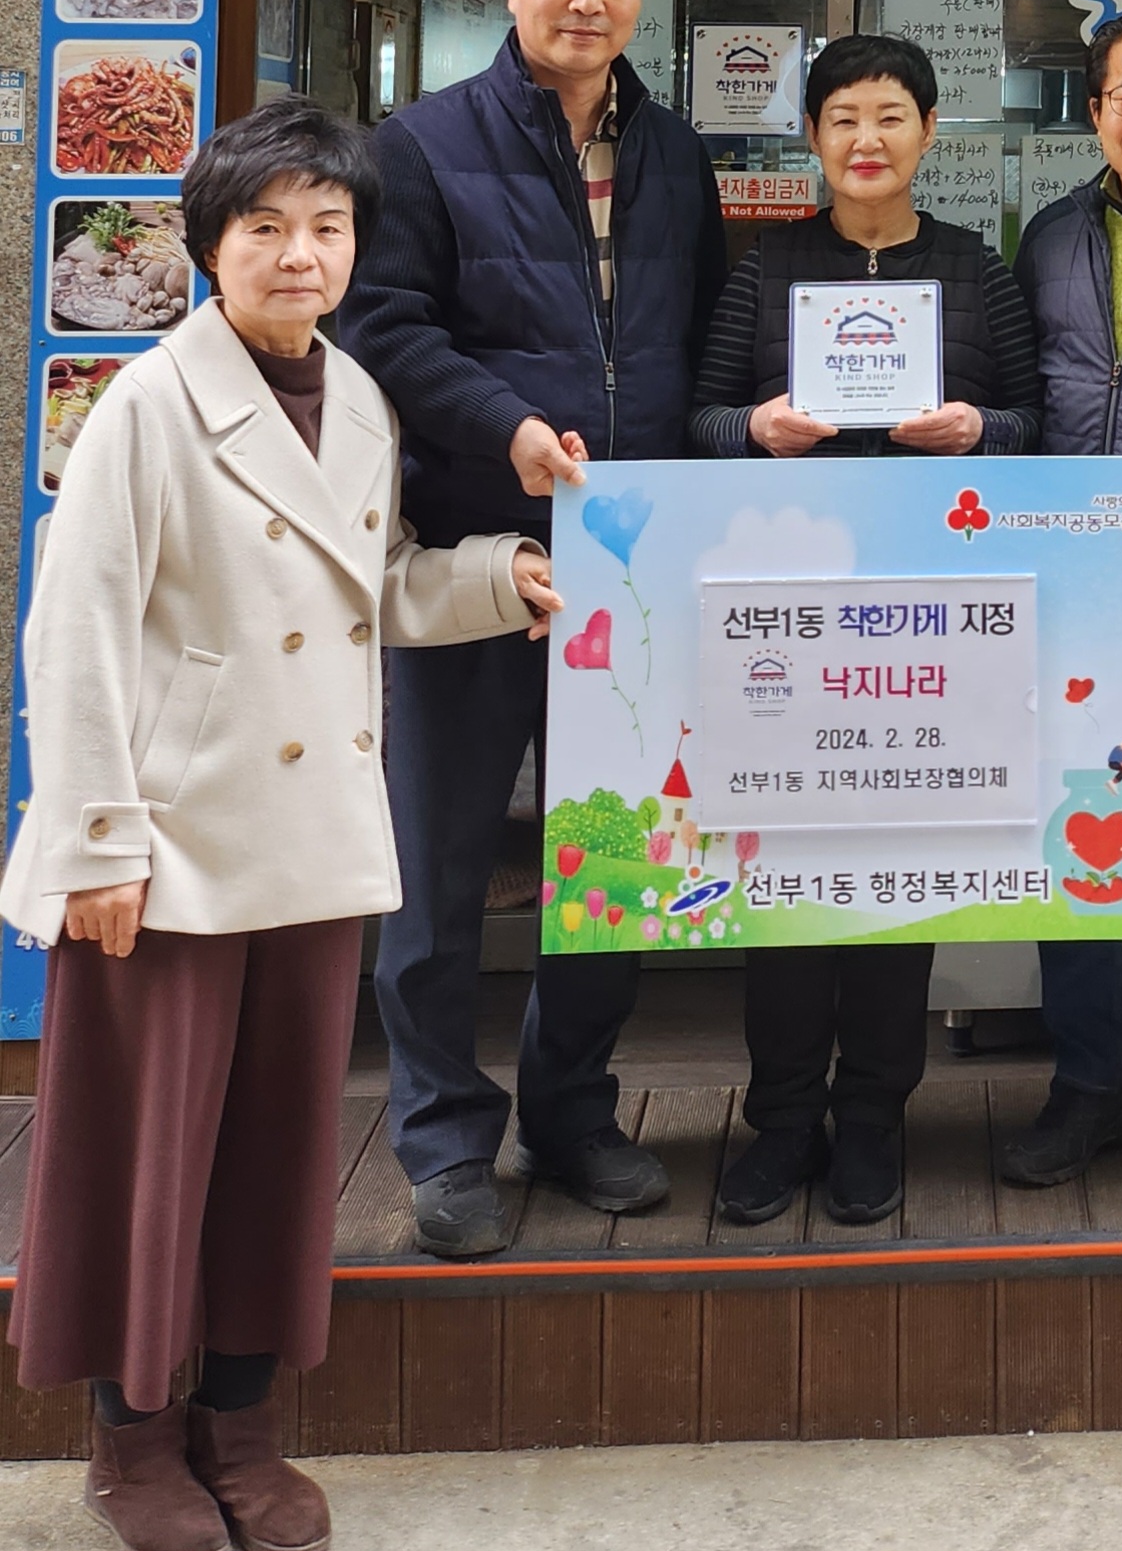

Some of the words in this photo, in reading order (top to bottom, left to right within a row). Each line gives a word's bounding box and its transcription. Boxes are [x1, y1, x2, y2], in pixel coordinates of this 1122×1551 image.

[716, 79, 777, 94] 착한가게
[730, 206, 752, 216] Not
[755, 206, 805, 217] Allowed
[825, 353, 906, 372] 착한가게
[834, 373, 862, 381] KIND
[866, 373, 896, 381] SHOP
[723, 606, 824, 639] 선부1동
[838, 604, 947, 637] 착한가게
[960, 602, 1015, 636] 지정
[743, 686, 793, 698] 착한가게
[823, 665, 947, 699] 낙지나라
[816, 729, 873, 749] 2024.
[885, 728, 903, 748] 2.
[915, 727, 946, 748] 28.
[729, 771, 804, 793] 선부1동
[817, 766, 1008, 791] 지역사회보장협의체
[746, 873, 857, 906] 선부1동
[869, 869, 1051, 904] 행정복지센터
